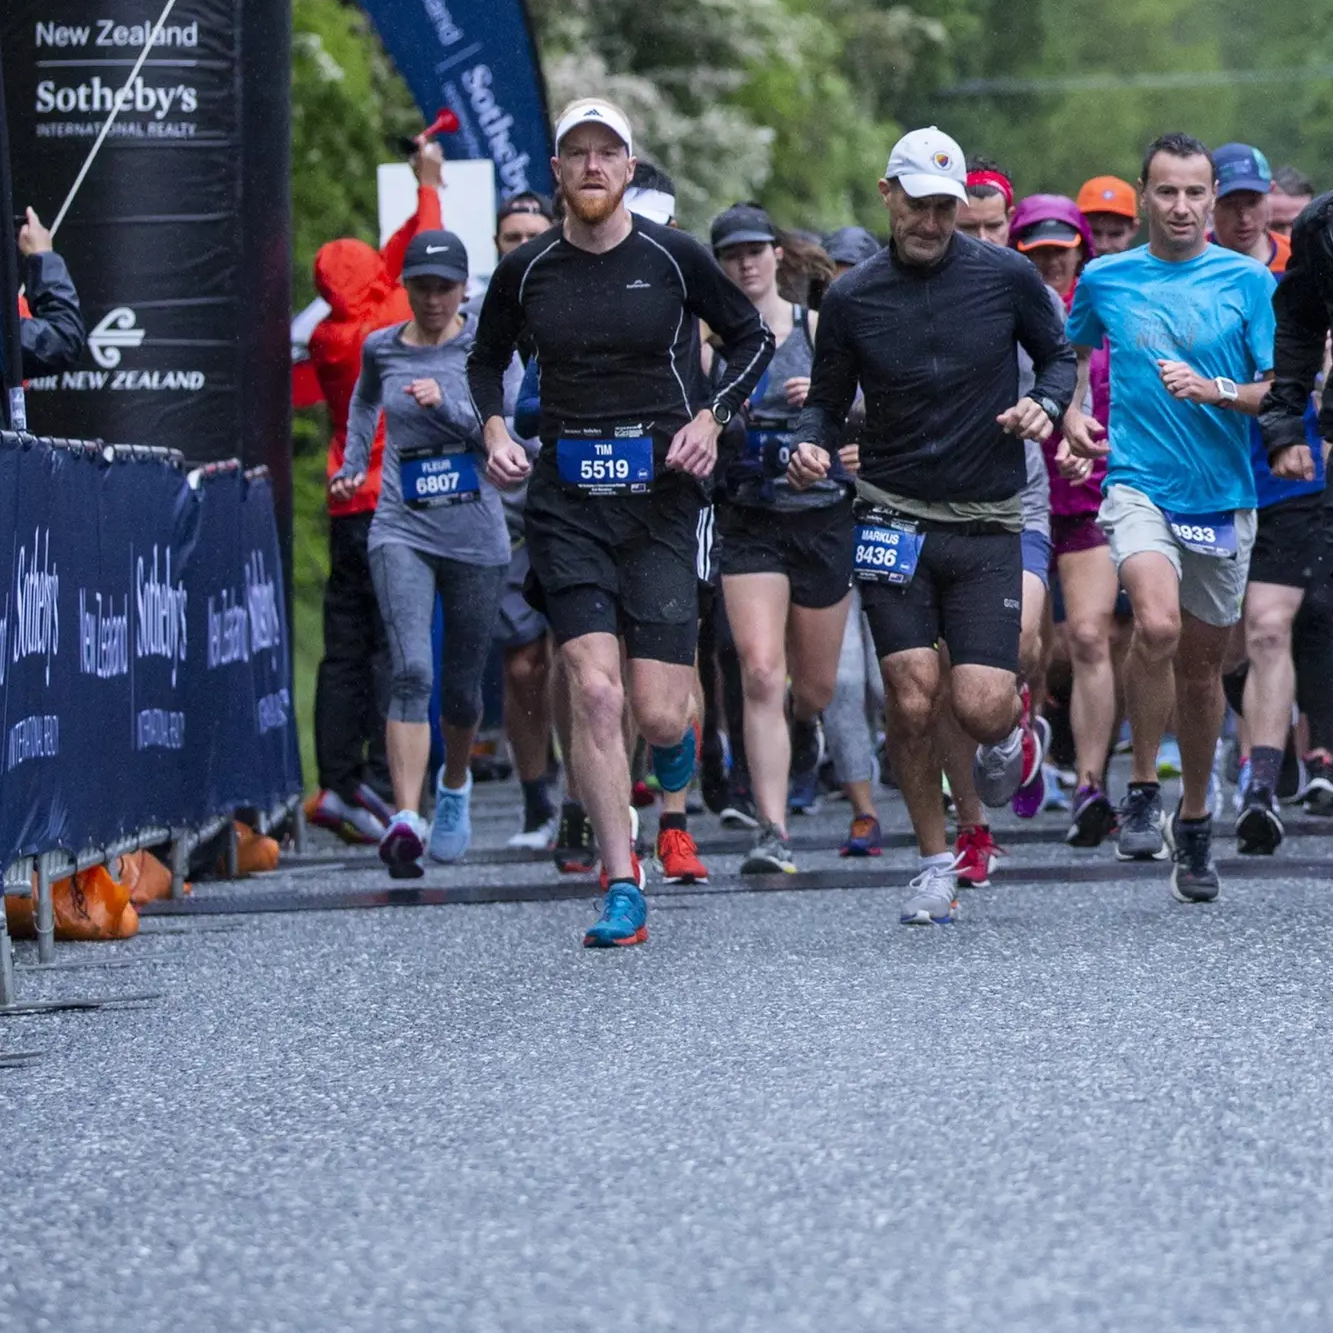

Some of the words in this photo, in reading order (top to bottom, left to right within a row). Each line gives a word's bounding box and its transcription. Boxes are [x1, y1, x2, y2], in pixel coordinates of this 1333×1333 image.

[35, 20, 90, 47] New
[95, 19, 199, 47] Zealand
[36, 76, 198, 120] Sotheby's
[36, 122, 144, 138] INTERNATONAL
[61, 370, 110, 390] NEW
[111, 370, 205, 391] ZEALAND
[594, 443, 612, 455] TIM
[580, 459, 629, 479] 5519
[416, 471, 460, 495] 6807
[861, 529, 900, 546] MARKUS
[855, 544, 898, 567] 8436
